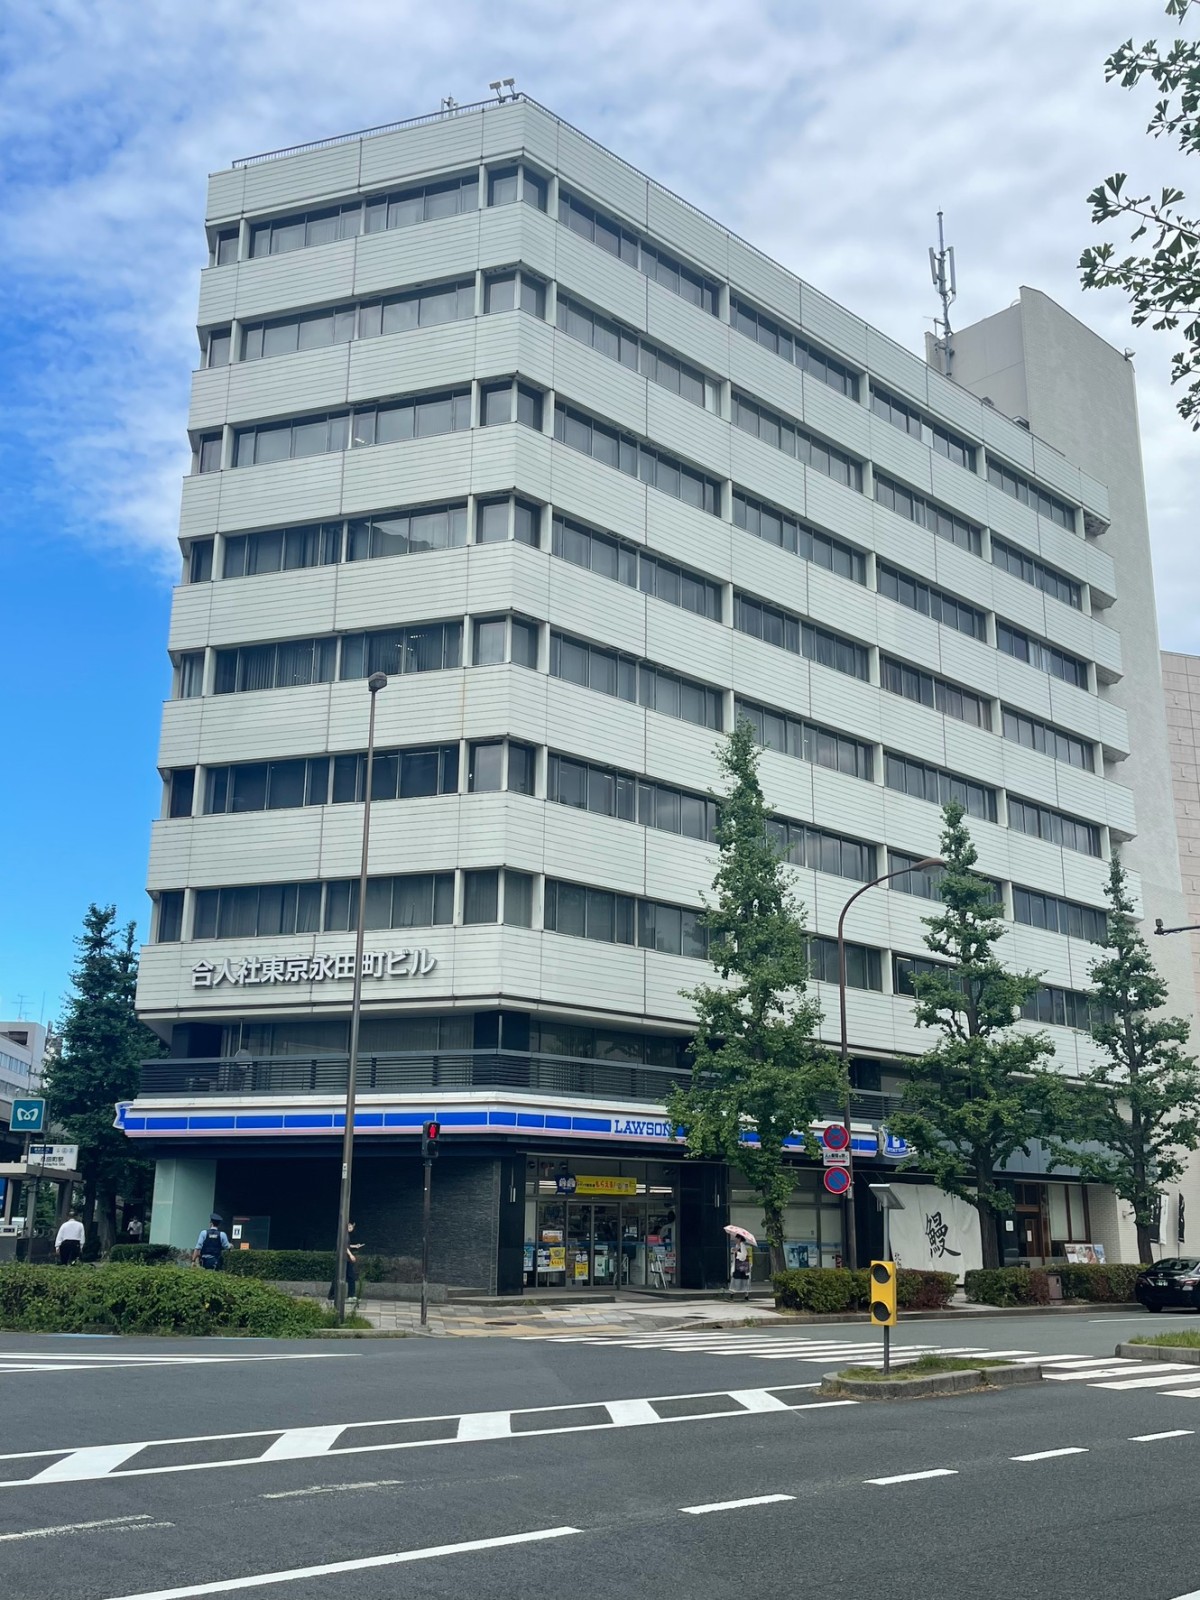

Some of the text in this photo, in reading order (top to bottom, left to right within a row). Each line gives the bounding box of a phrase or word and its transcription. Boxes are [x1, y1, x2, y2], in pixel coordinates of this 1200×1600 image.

[191, 948, 436, 987] 合人社東京永田町ビル
[614, 1119, 672, 1136] LAWSON
[925, 1211, 961, 1258] 鰻
